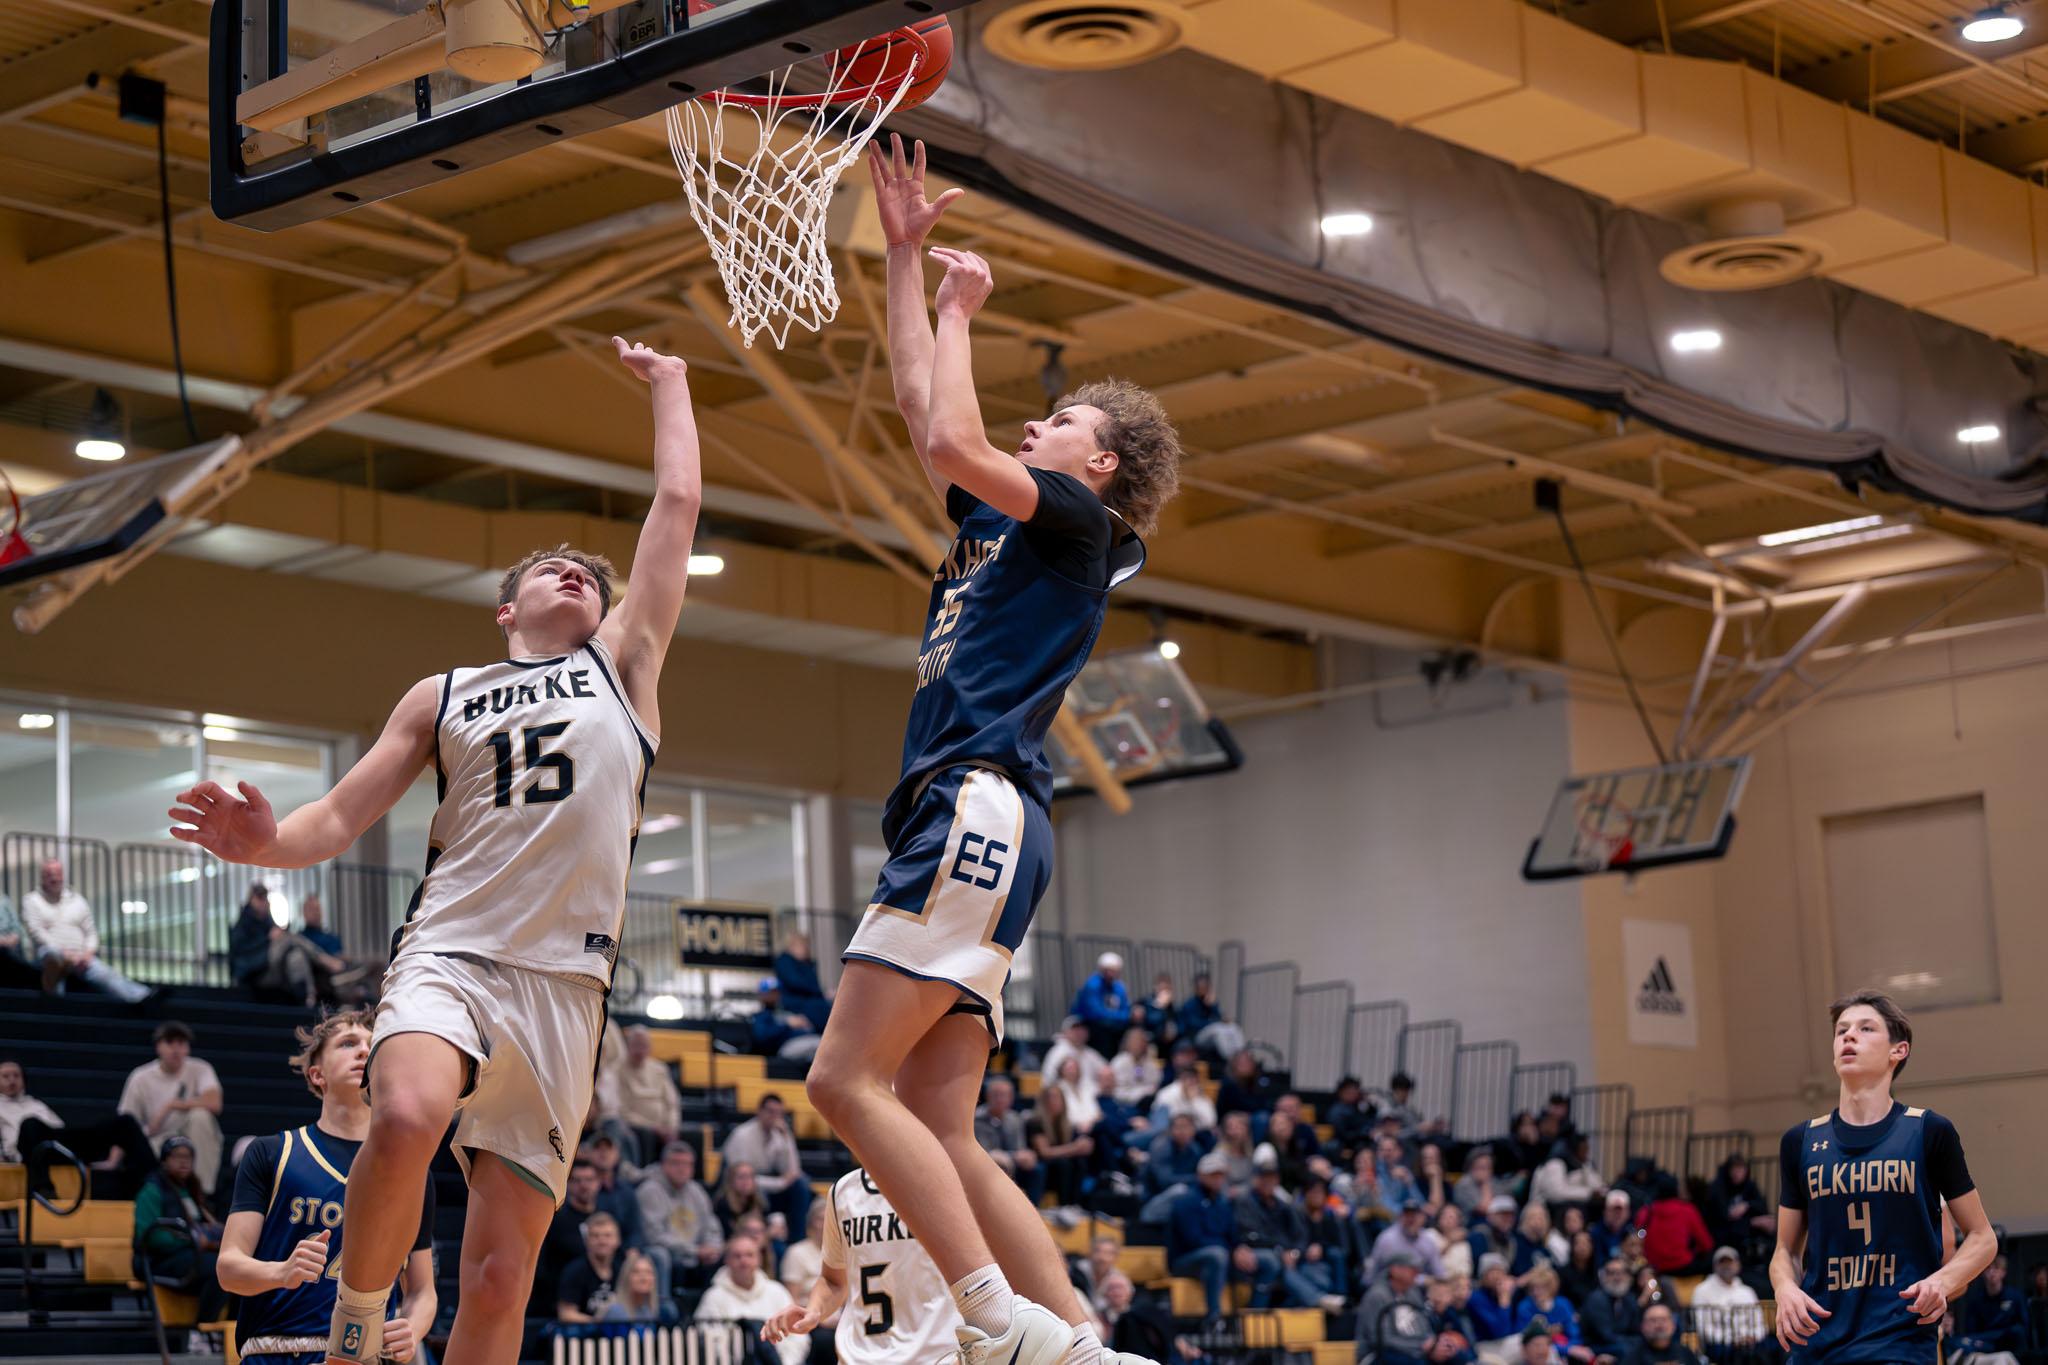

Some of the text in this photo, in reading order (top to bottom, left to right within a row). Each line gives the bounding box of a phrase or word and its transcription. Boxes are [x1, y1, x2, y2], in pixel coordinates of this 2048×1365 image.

[929, 581, 972, 642] 35
[463, 669, 597, 722] BURKE
[484, 719, 576, 811] 15
[950, 831, 1008, 891] ES
[679, 913, 769, 956] HOME
[1807, 1160, 1916, 1200] ELKHORN
[289, 1197, 344, 1229] STO
[1847, 1201, 1872, 1246] 4
[1828, 1254, 1896, 1291] SOUTH
[860, 1262, 894, 1336] 5
